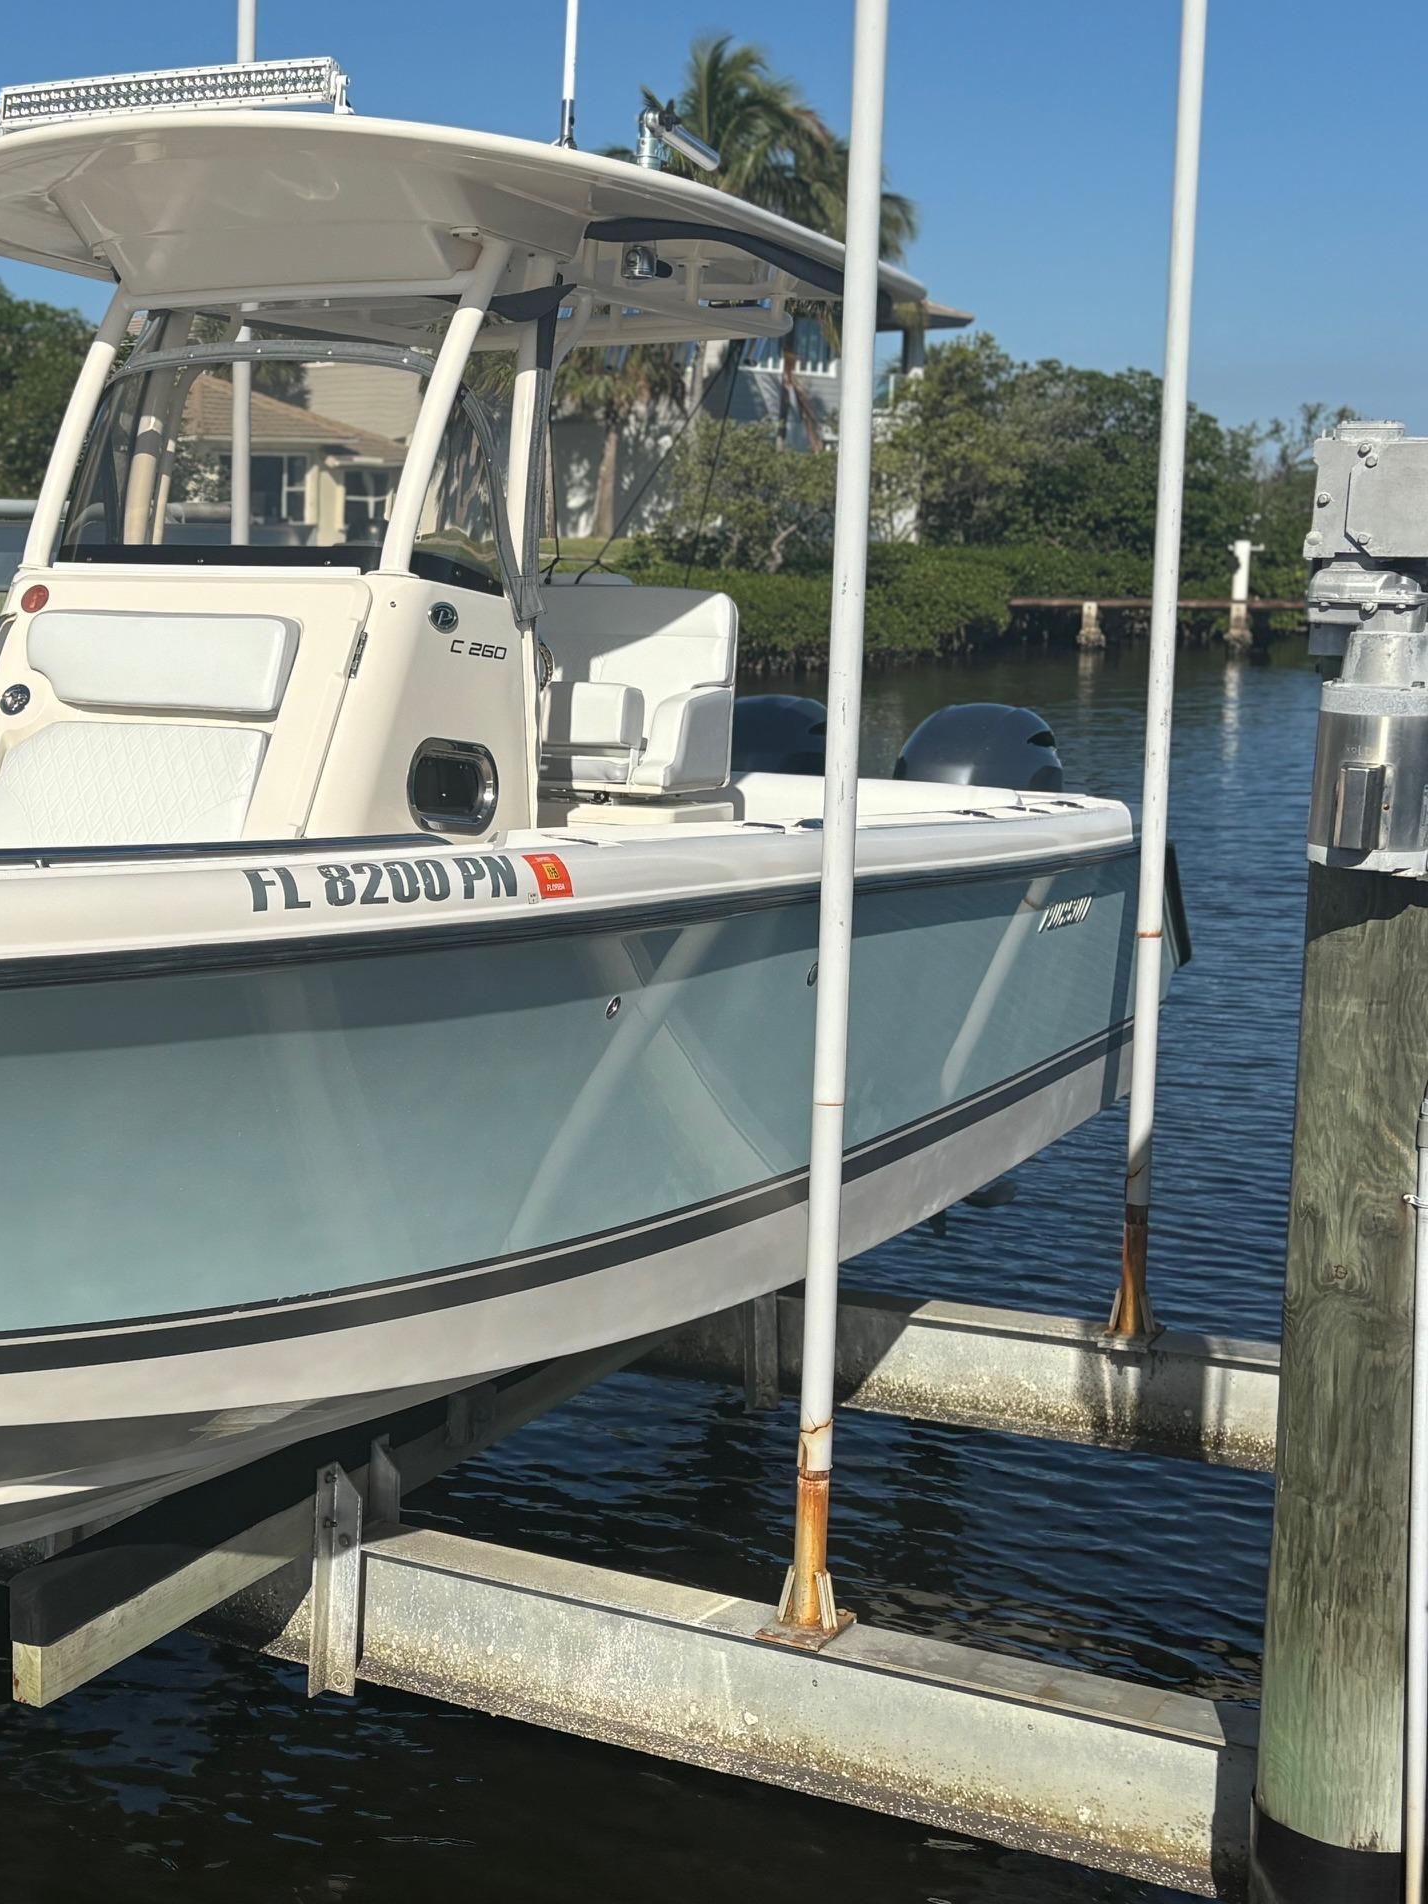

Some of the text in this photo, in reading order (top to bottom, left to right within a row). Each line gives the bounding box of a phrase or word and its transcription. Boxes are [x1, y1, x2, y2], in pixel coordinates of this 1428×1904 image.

[450, 639, 508, 660] C 260
[242, 855, 518, 912] FL 8200 PN
